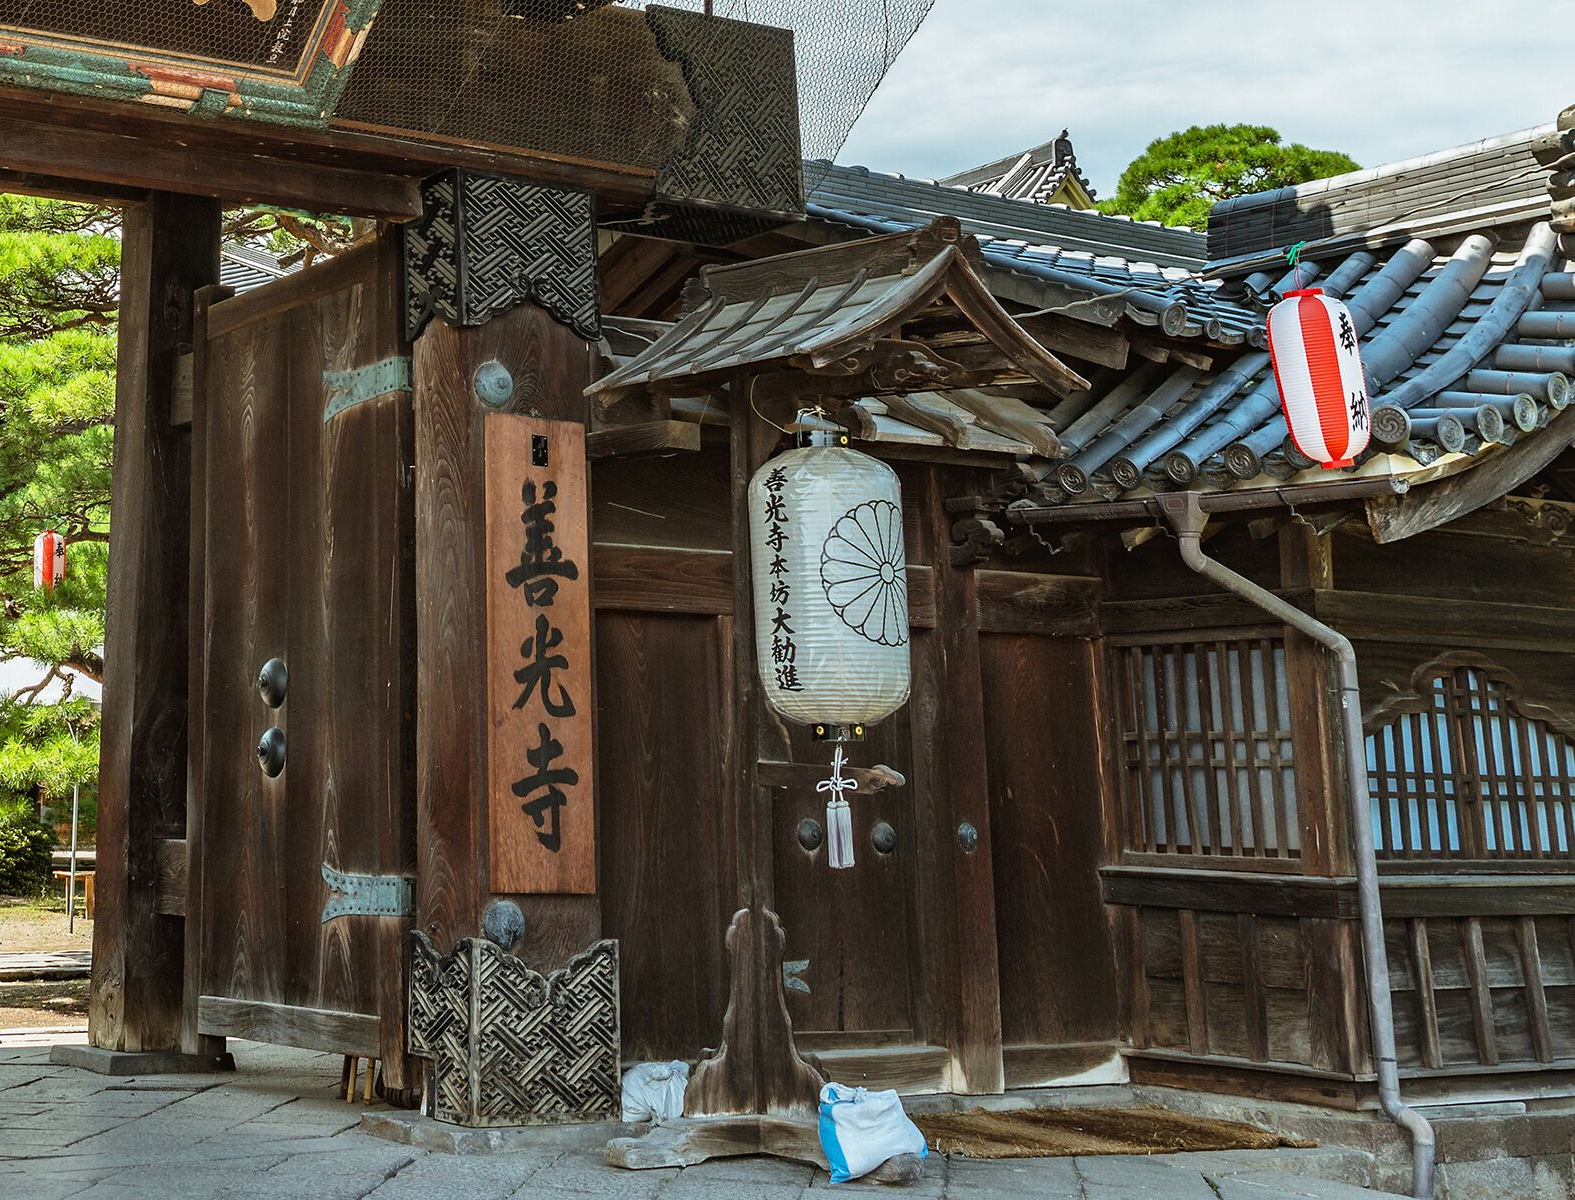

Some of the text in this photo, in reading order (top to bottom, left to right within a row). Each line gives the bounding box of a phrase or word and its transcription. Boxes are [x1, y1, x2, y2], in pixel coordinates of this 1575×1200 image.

[1339, 311, 1369, 433] 奉納
[505, 477, 579, 853] 善光寺
